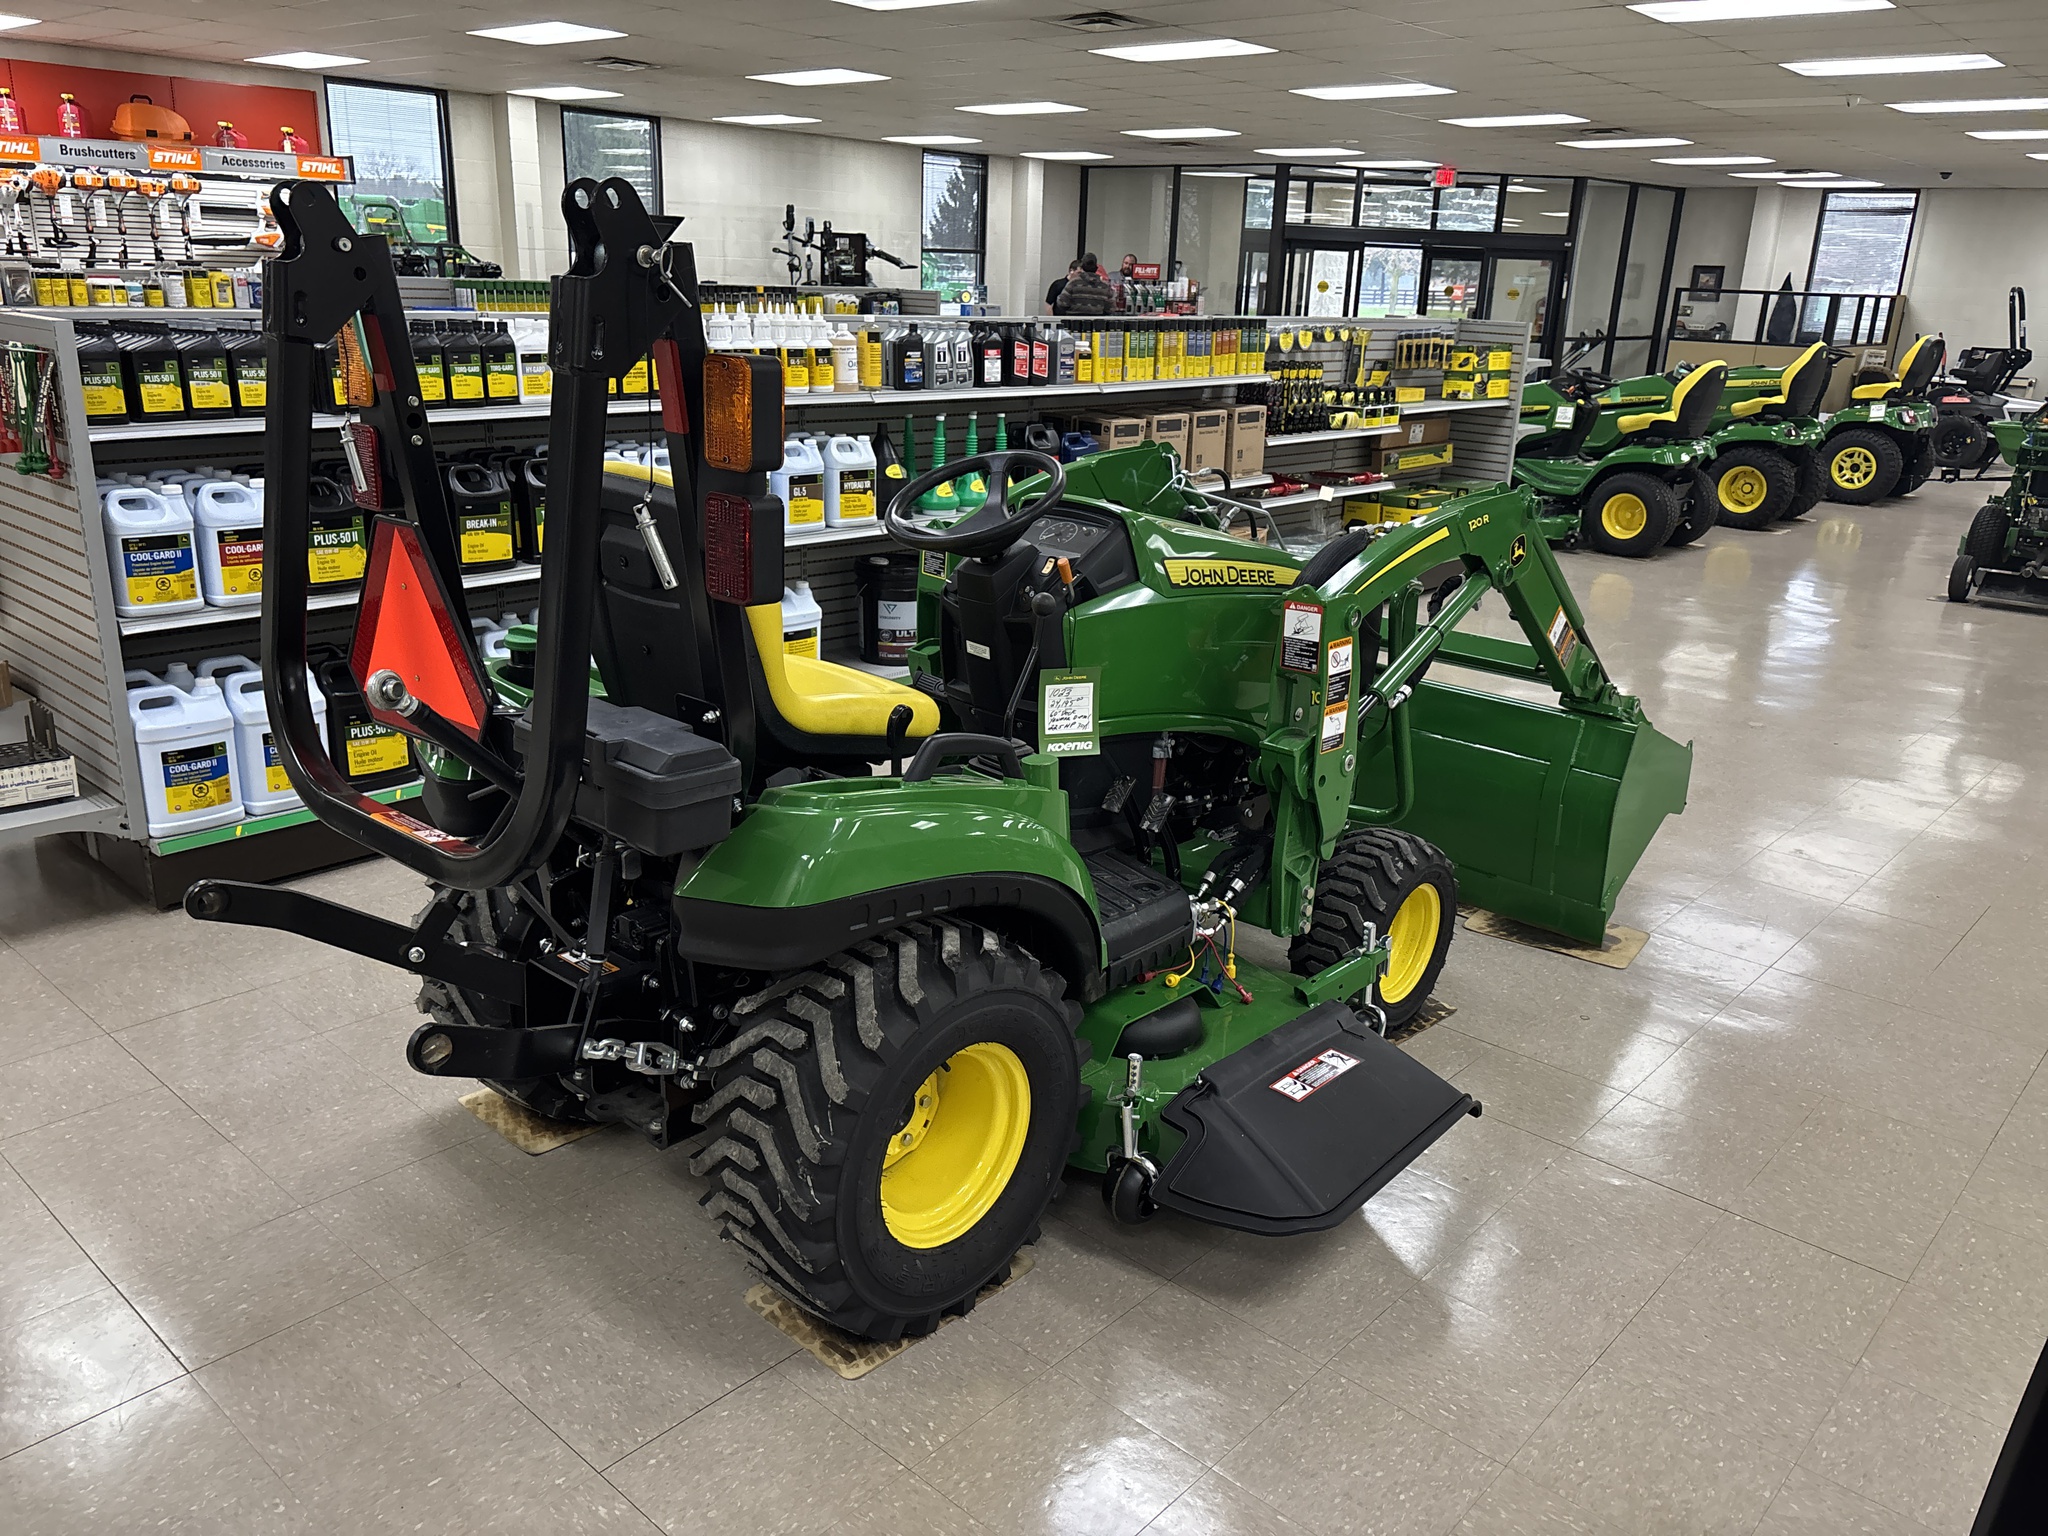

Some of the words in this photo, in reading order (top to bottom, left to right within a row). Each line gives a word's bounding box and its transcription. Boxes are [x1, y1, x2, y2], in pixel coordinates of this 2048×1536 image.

[0, 140, 34, 155] TIHL
[59, 144, 136, 160] Brushcutters
[152, 151, 197, 164] STIHL
[221, 155, 286, 170] Accessories
[300, 161, 341, 174] STIHL
[1436, 170, 1455, 186] EXIT
[193, 370, 217, 378] PLUS-50
[242, 369, 266, 377] PLUS-50
[416, 366, 441, 375] URF-GARD
[83, 376, 110, 385] PLUS-50
[144, 374, 169, 383] PLUS-50
[793, 486, 807, 497] GL-5
[466, 518, 498, 529] BREAK-IN
[313, 531, 352, 547] PLUS-50
[351, 531, 359, 542] II
[130, 550, 176, 562] COOL-GARD
[176, 550, 183, 558] II
[1181, 566, 1224, 584] JOHN
[1226, 565, 1276, 584] DEERE
[1296, 604, 1318, 612] DANGER
[895, 630, 916, 638] ULT
[1333, 637, 1352, 648] WARNING
[169, 759, 212, 774] COOL-GARD
